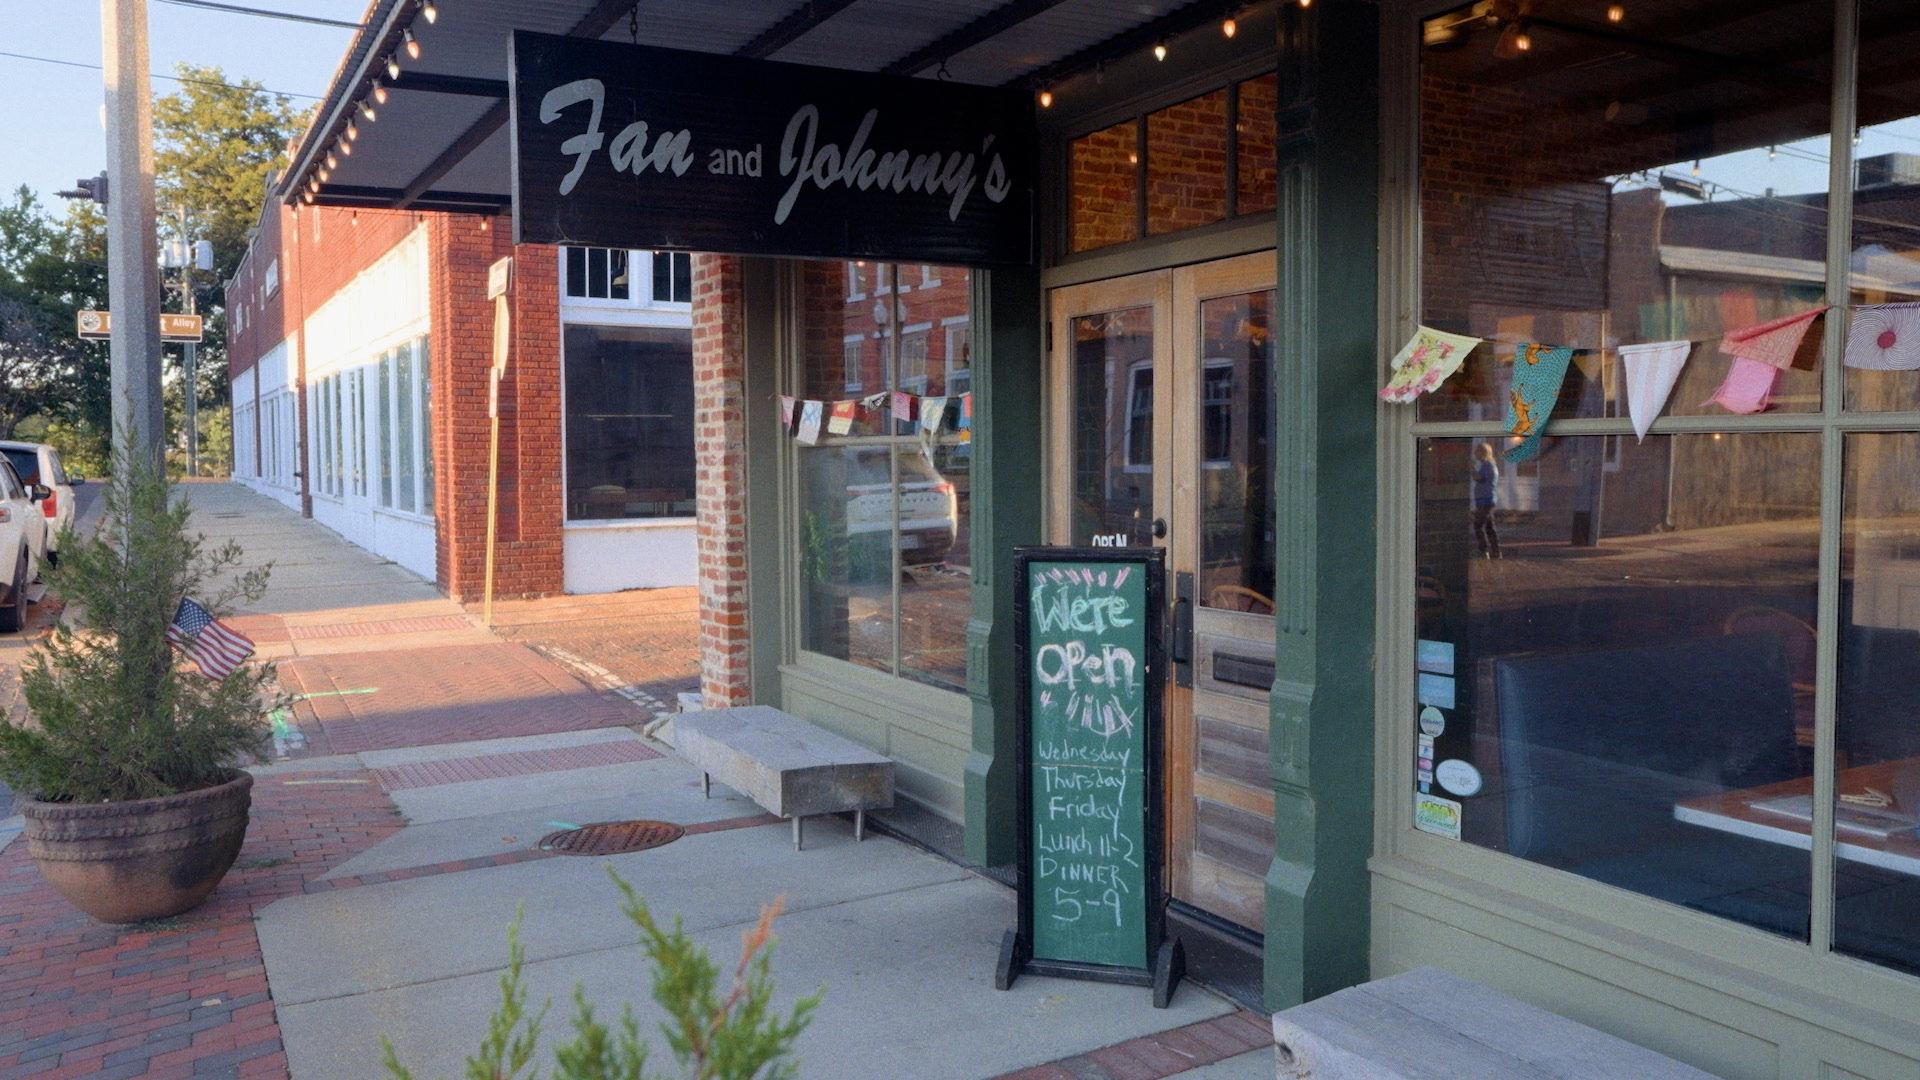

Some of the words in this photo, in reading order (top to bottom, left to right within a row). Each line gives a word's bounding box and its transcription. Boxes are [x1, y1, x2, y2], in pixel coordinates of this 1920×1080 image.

[539, 78, 694, 196] Fan
[707, 143, 762, 178] and
[774, 104, 1011, 226] Johnny's
[172, 318, 196, 329] Alley
[1038, 739, 1131, 767] Wednesday
[1041, 766, 1126, 806] Thursday
[1049, 794, 1119, 842] Friday
[1039, 824, 1092, 855] Lunch
[1040, 855, 1129, 893] DINNER
[1052, 886, 1121, 926] 5-9
